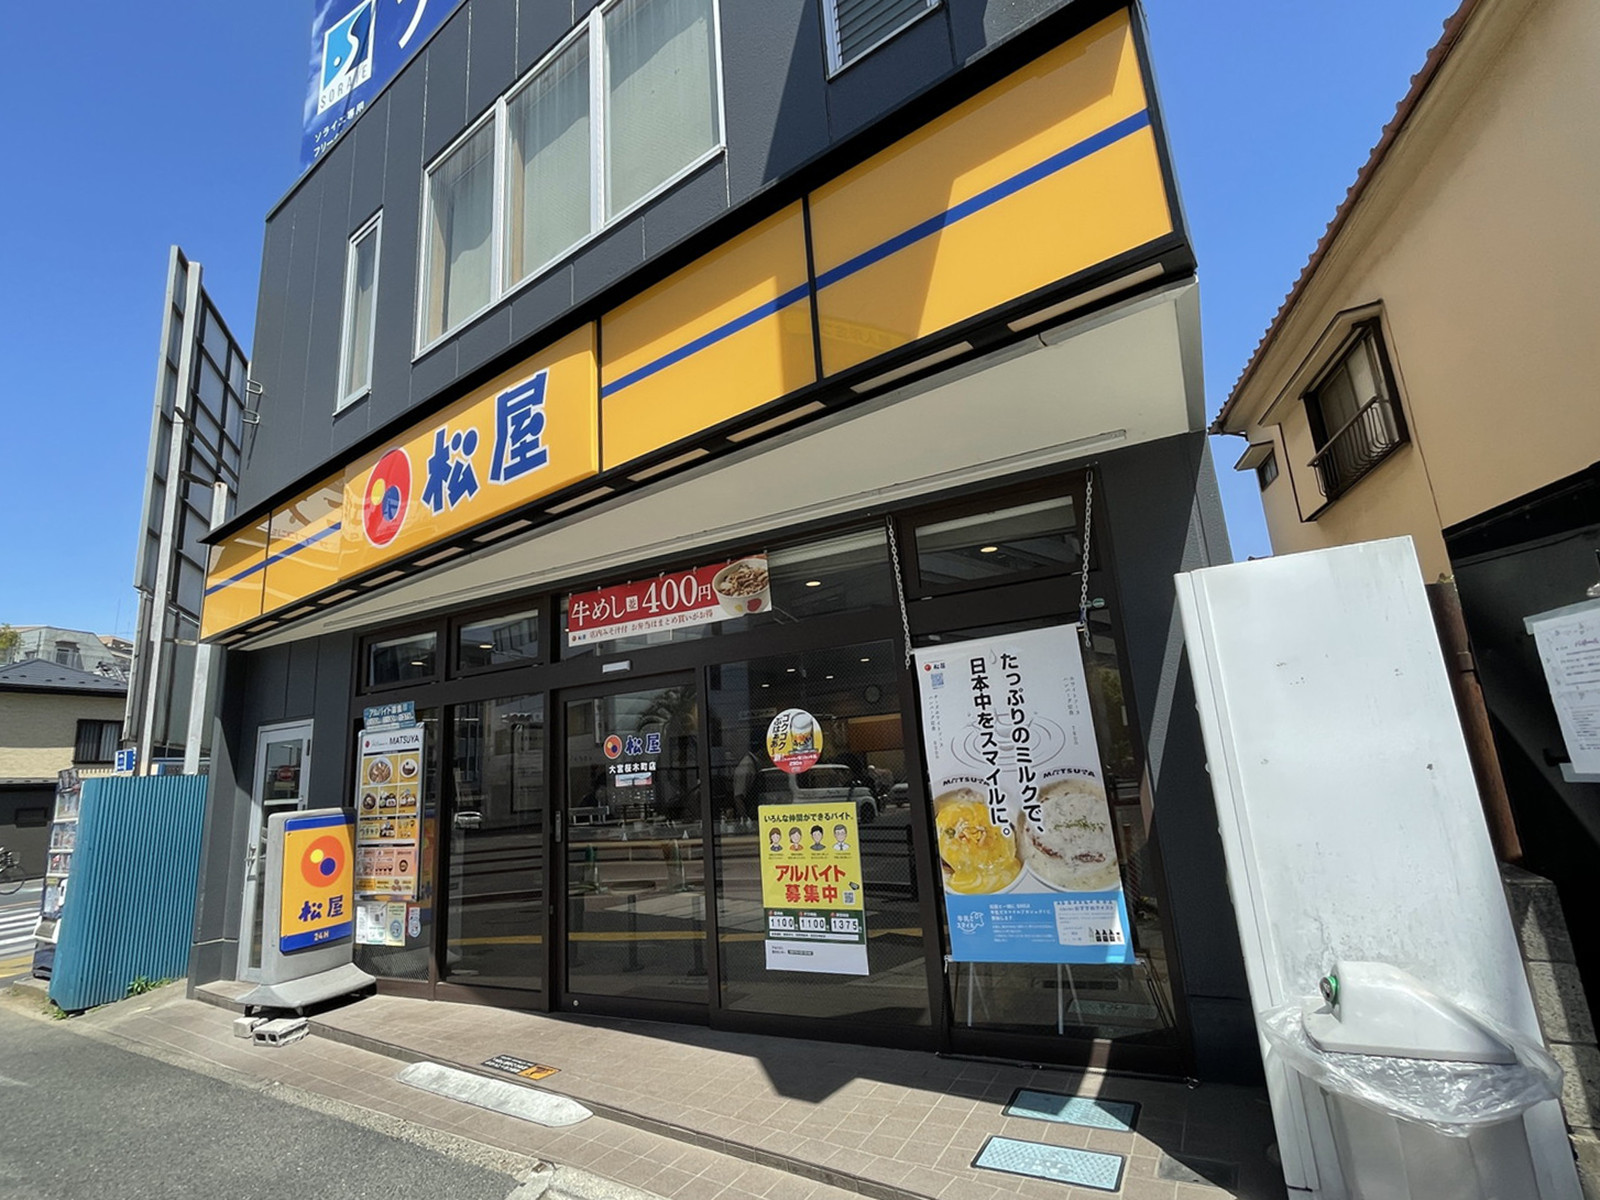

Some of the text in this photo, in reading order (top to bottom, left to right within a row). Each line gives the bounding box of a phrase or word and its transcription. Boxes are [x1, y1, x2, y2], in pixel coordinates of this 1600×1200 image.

[420, 367, 550, 517] 松屋
[571, 595, 626, 627] 牛めし
[641, 574, 712, 614] 400円
[624, 732, 661, 756] 松屋
[969, 656, 1011, 836] 日本中をスマイルに。
[1000, 652, 1045, 833] たっぷりのミルクで、
[775, 864, 846, 882] アルバイト
[785, 884, 838, 903] 募集中
[298, 894, 344, 922] 松屋
[770, 918, 793, 928] 1100
[801, 919, 825, 929] 1100
[833, 920, 858, 931] 1375
[313, 930, 330, 942] 24H
